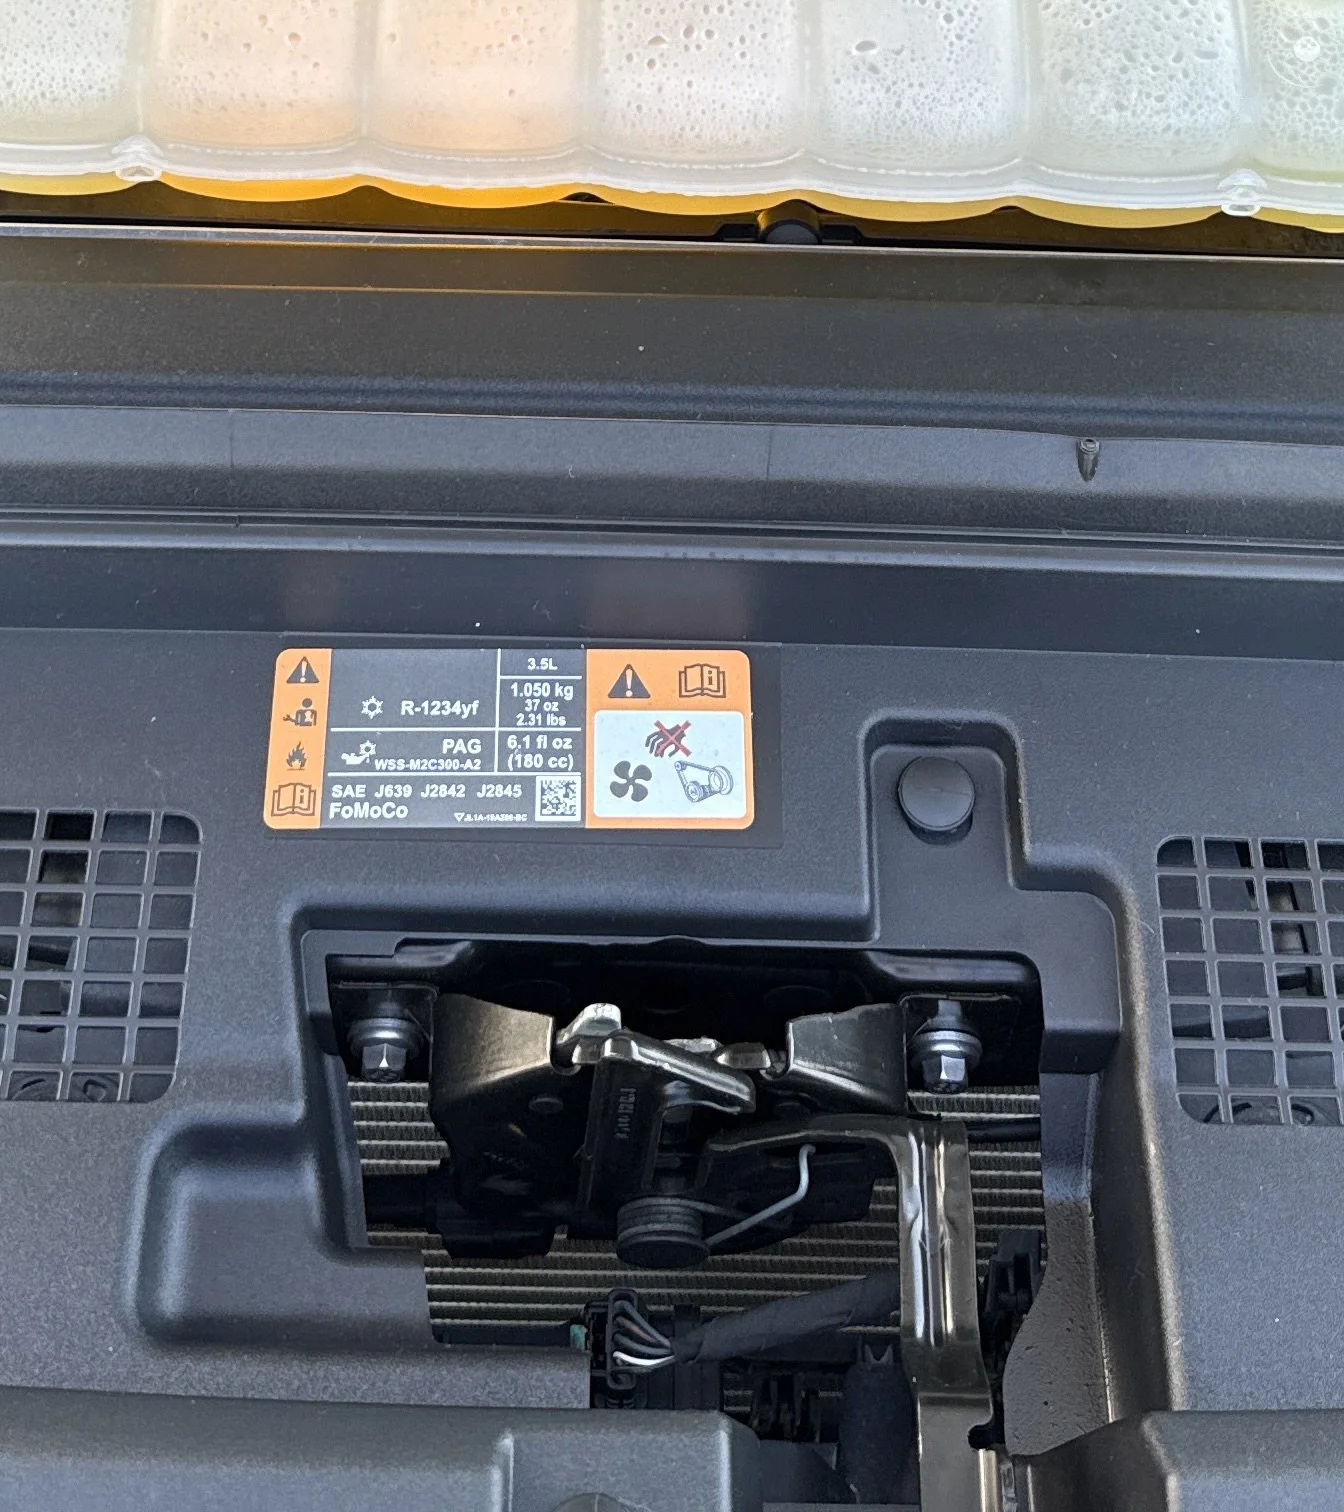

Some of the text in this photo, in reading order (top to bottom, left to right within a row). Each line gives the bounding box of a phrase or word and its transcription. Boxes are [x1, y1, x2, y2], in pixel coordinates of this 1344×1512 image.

[528, 658, 557, 670] 3.5L
[511, 682, 574, 701] 1.050 kg
[401, 700, 479, 719] R-1234yf
[525, 699, 559, 711] 37 oz
[516, 713, 566, 726] 2.31 lbs
[443, 739, 481, 754] PAG
[507, 735, 572, 751] 6.1 fl oz
[375, 759, 481, 770] WSS-M2C300-A2
[508, 752, 574, 772] (180 cc)
[332, 784, 522, 798] SAE J639 J2842 J2845
[329, 802, 408, 819] FoMoCo
